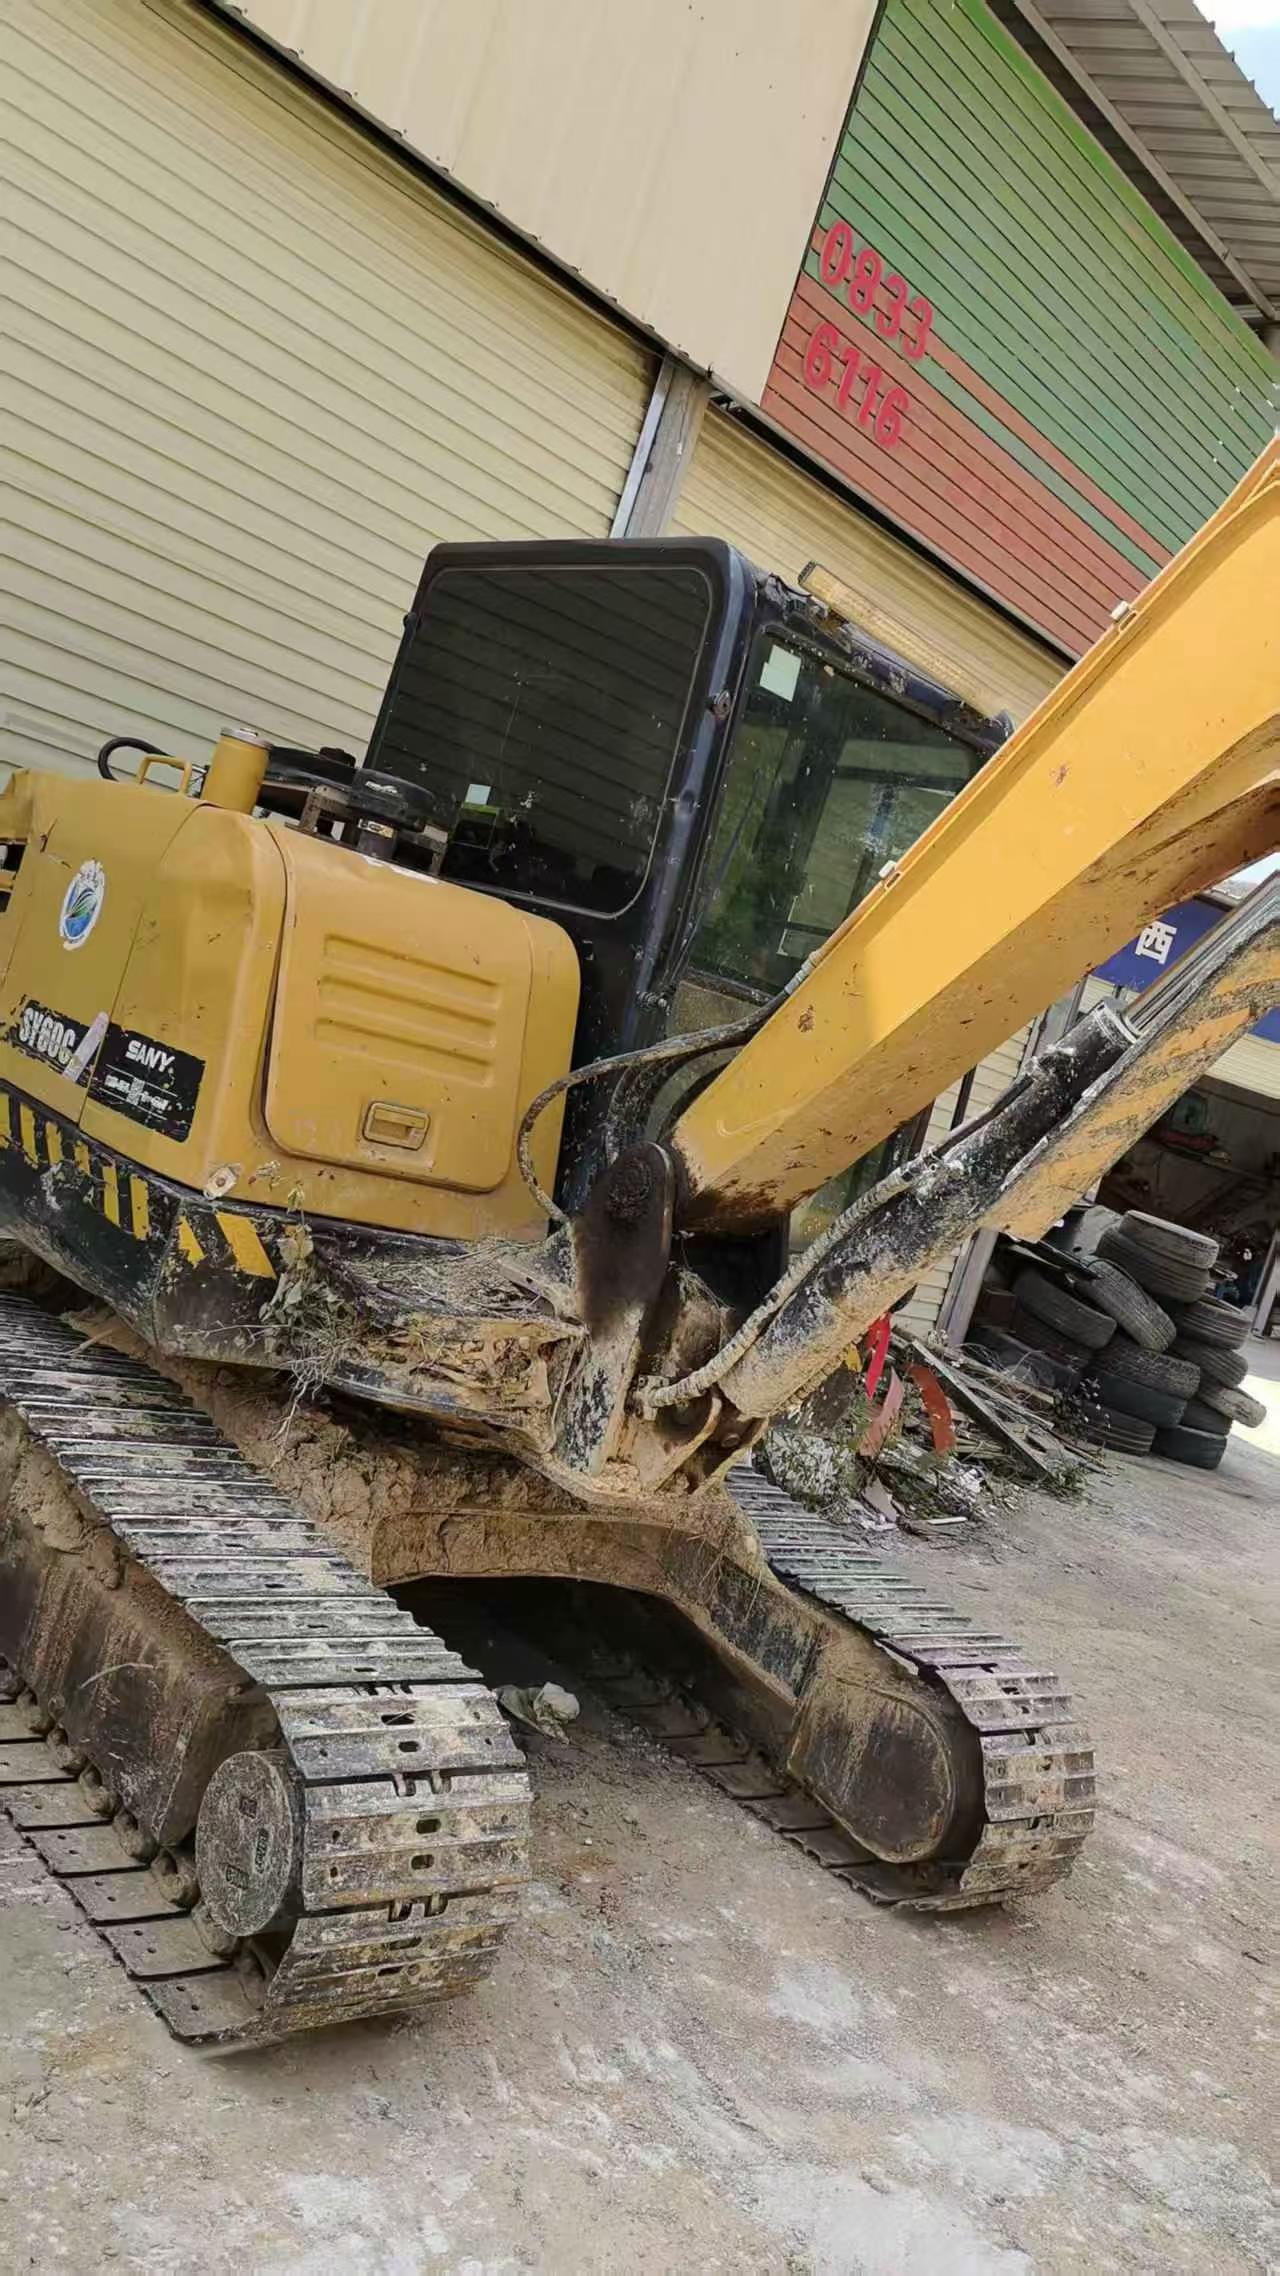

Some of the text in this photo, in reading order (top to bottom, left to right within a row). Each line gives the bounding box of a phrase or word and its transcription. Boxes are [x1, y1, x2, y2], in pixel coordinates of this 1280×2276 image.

[820, 219, 933, 360] 0833
[1135, 921, 1177, 964] 西
[125, 1039, 175, 1073] SANY
